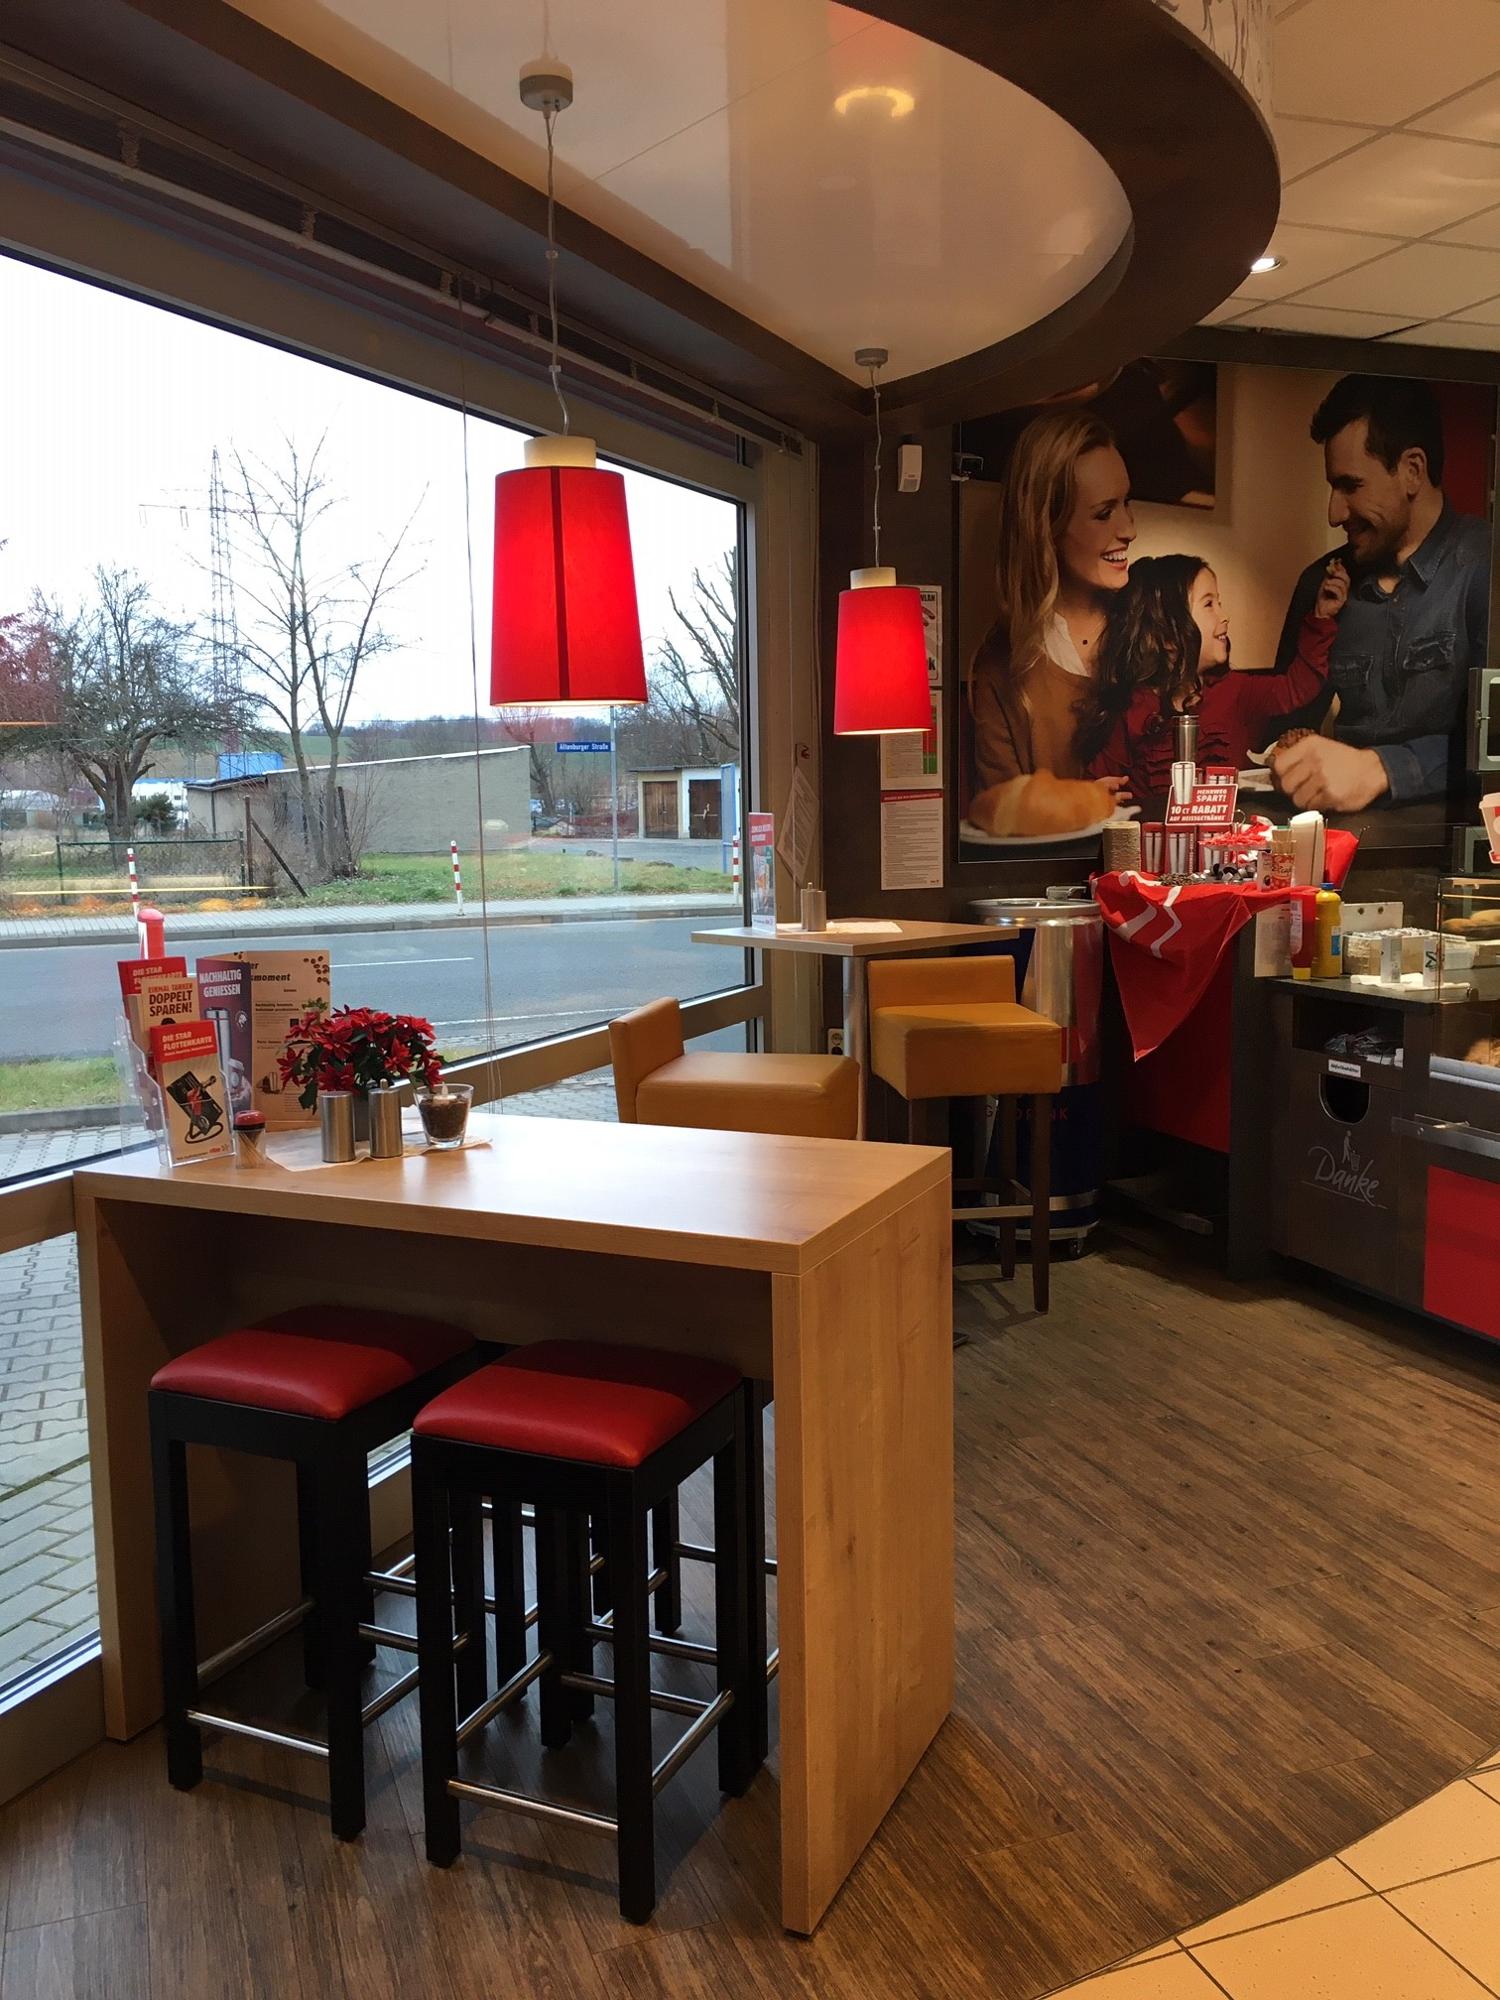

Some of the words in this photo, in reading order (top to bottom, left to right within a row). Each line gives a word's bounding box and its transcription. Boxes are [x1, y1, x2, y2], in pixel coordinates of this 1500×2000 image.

[559, 743, 590, 751] Altenburger
[1196, 794, 1227, 802] SPART!
[1171, 806, 1182, 814] 10
[1191, 804, 1229, 814] RABATT
[199, 968, 242, 984] NACHHALTIG
[149, 990, 193, 1005] DOPPELT
[203, 983, 241, 998] GENIESSEN
[149, 1002, 193, 1017] SPAREN!
[162, 1033, 174, 1043] DIE
[175, 1031, 192, 1041] STAR
[163, 1036, 213, 1051] FLOTTENKARTE
[1308, 1146, 1380, 1206] Danke
